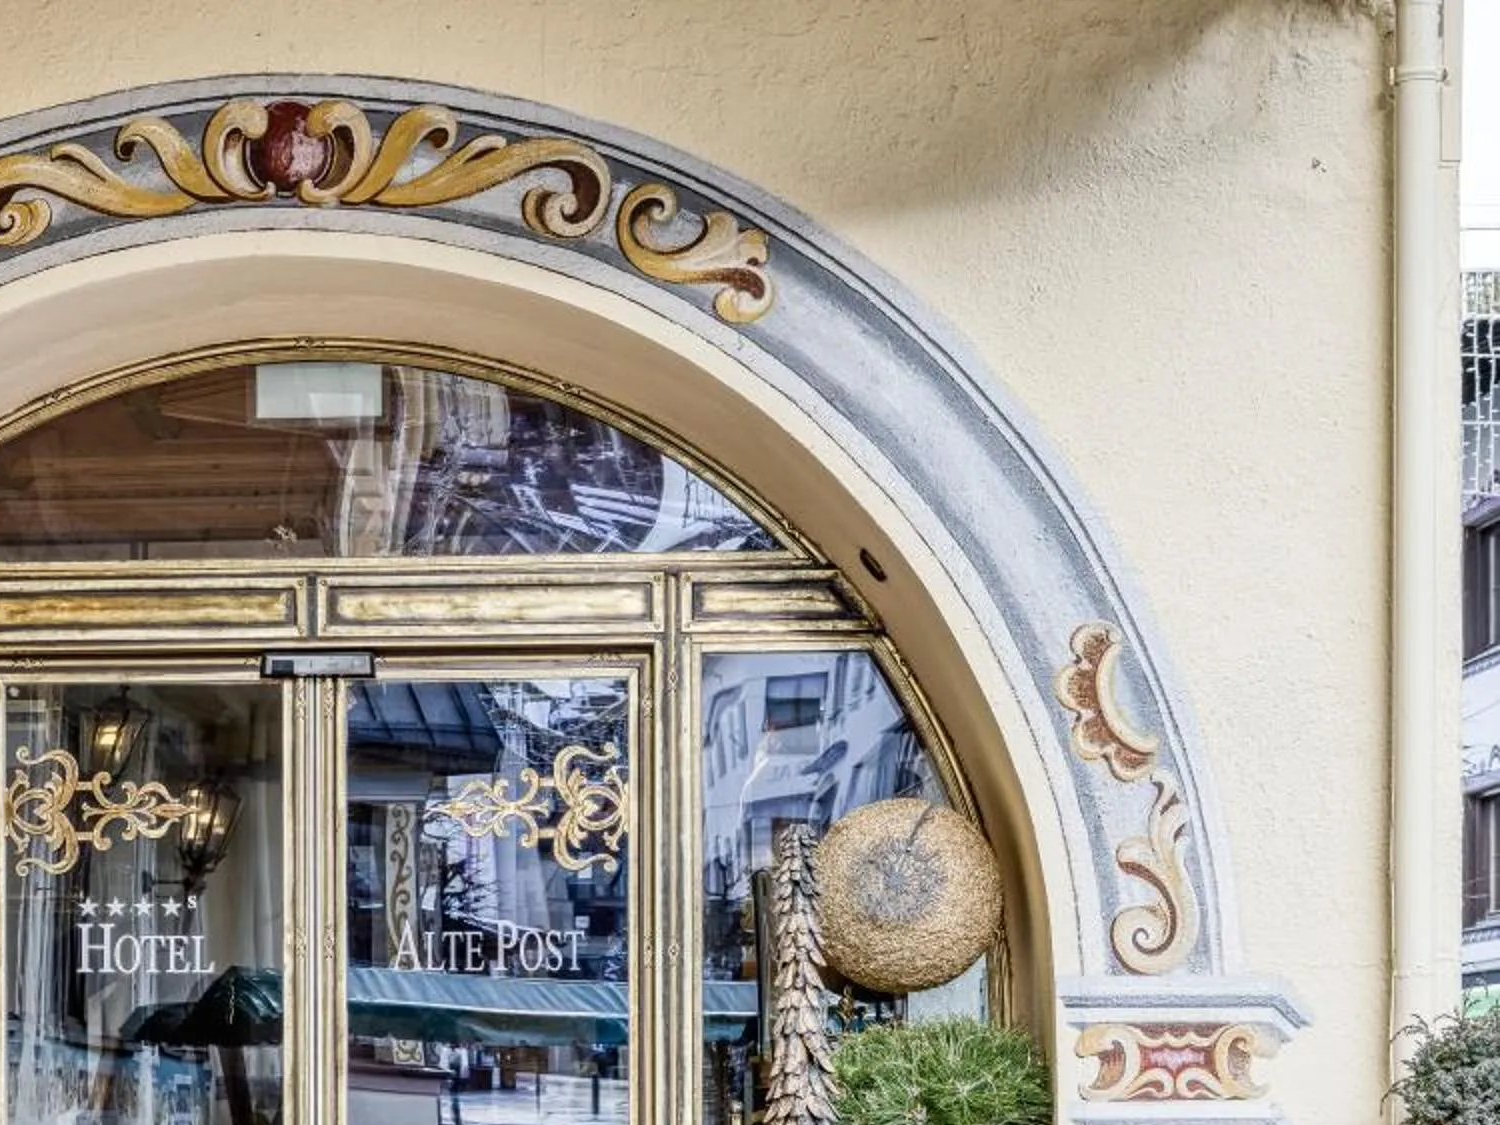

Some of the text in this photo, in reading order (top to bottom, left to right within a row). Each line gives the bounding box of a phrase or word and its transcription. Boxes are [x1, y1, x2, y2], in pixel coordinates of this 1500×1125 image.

[76, 923, 216, 974] HOTEL
[394, 919, 585, 972] ALTE POST
